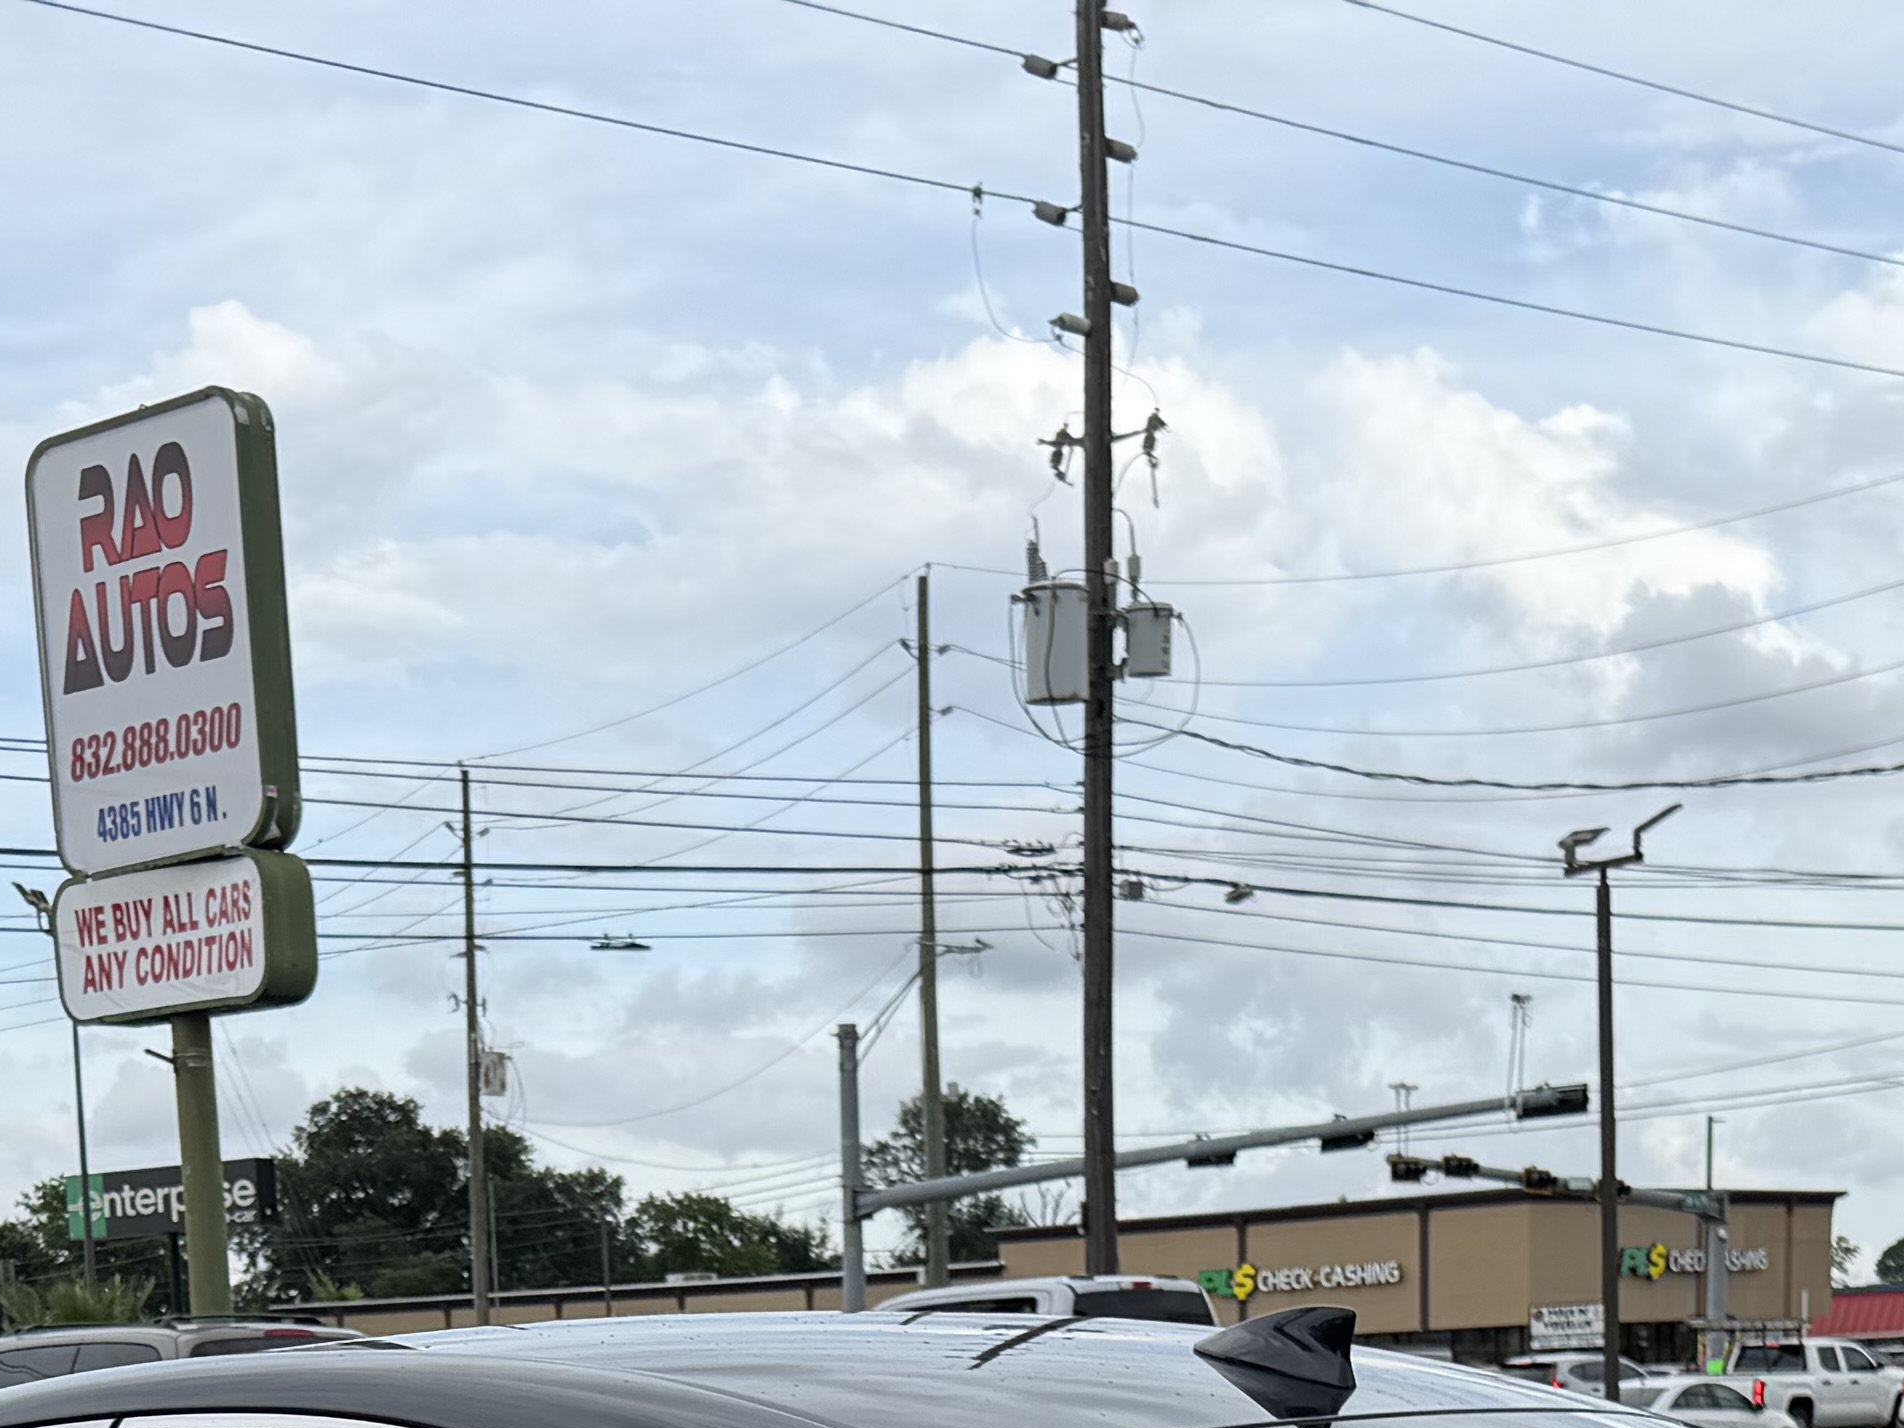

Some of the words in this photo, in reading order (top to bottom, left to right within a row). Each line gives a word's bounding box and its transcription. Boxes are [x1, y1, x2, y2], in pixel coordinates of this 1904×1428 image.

[78, 441, 193, 573] RAO
[63, 549, 234, 695] AUTOS
[71, 702, 242, 782] 832.888.0300
[97, 801, 142, 843] 4385
[144, 791, 185, 833] HWY
[189, 789, 202, 826] 6
[74, 906, 108, 948] WE
[111, 898, 153, 943] BUY
[162, 892, 200, 936] ALL
[205, 879, 252, 928] CARS
[83, 950, 128, 995] ANY
[135, 927, 253, 987] CONDITION
[1257, 1267, 1315, 1293] CHECK
[1319, 1260, 1402, 1289] CASHING
